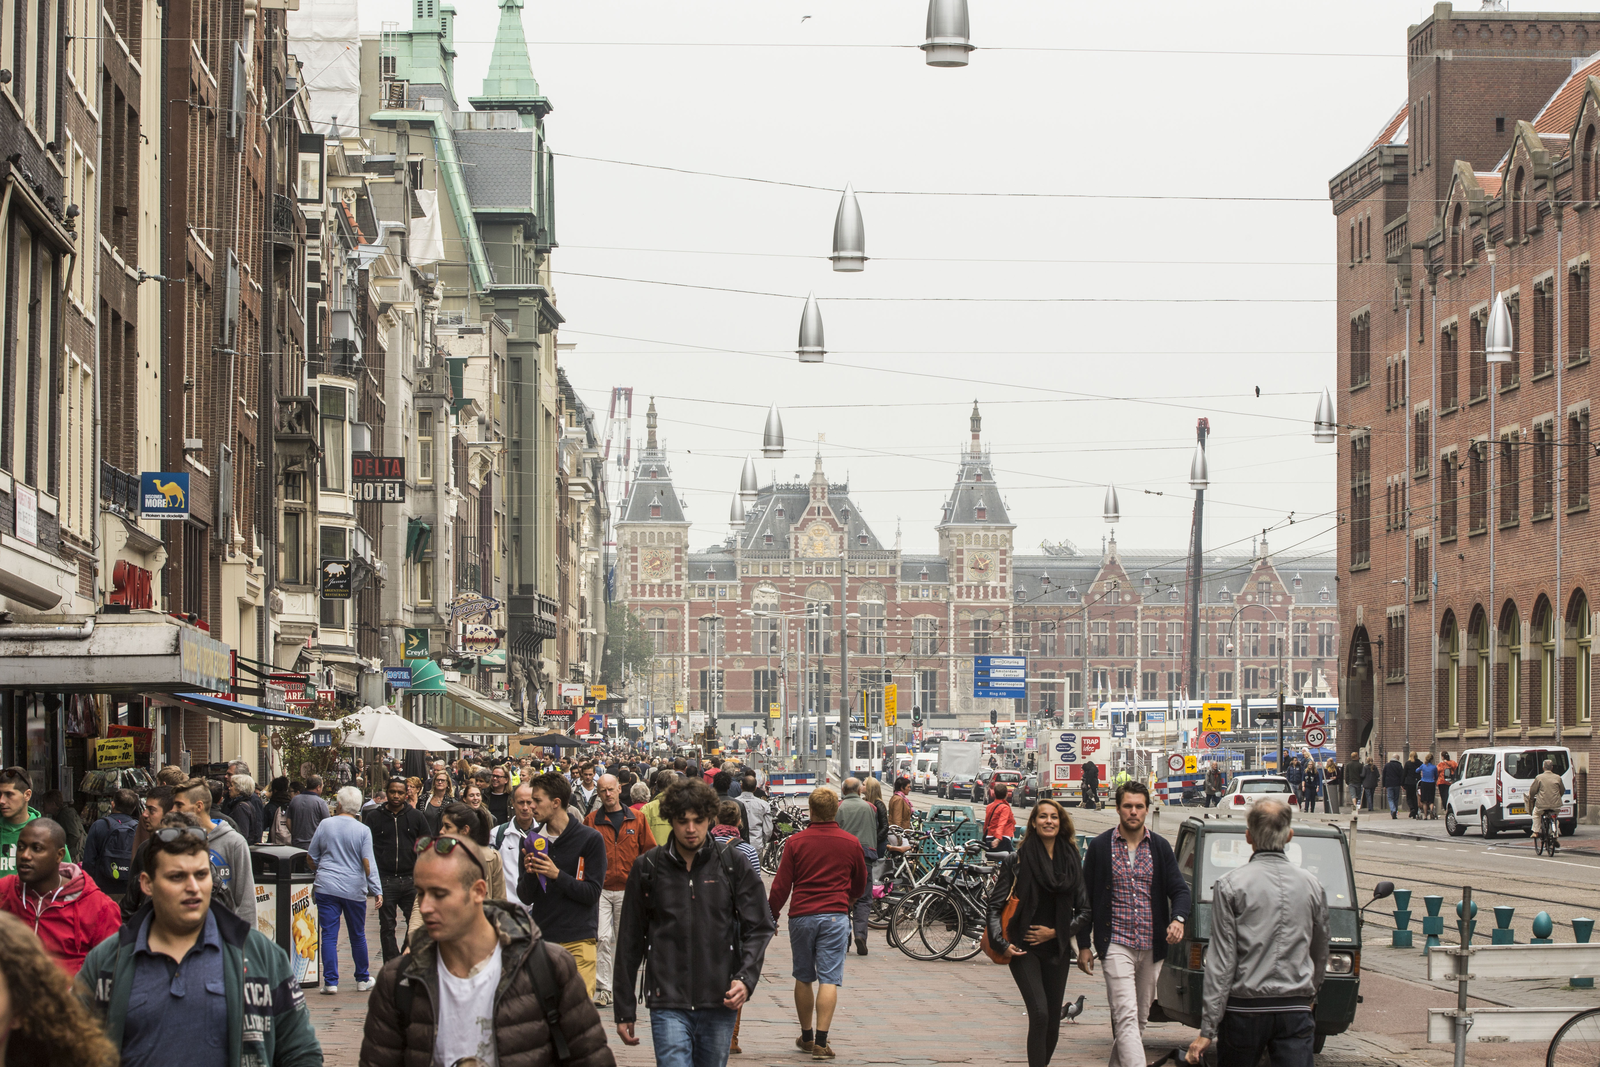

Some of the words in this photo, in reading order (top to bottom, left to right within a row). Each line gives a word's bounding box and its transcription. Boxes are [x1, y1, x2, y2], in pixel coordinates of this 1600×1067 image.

[353, 458, 401, 476] DELTA
[352, 482, 404, 501] HOTEL
[144, 498, 167, 508] MORE
[461, 635, 500, 644] Heineken
[406, 648, 429, 657] Creyf's
[386, 671, 411, 680] HOTEL
[1309, 733, 1324, 743] 30
[220, 868, 230, 876] 03
[291, 886, 310, 904] VLAAMSE
[292, 895, 310, 917] FRITES
